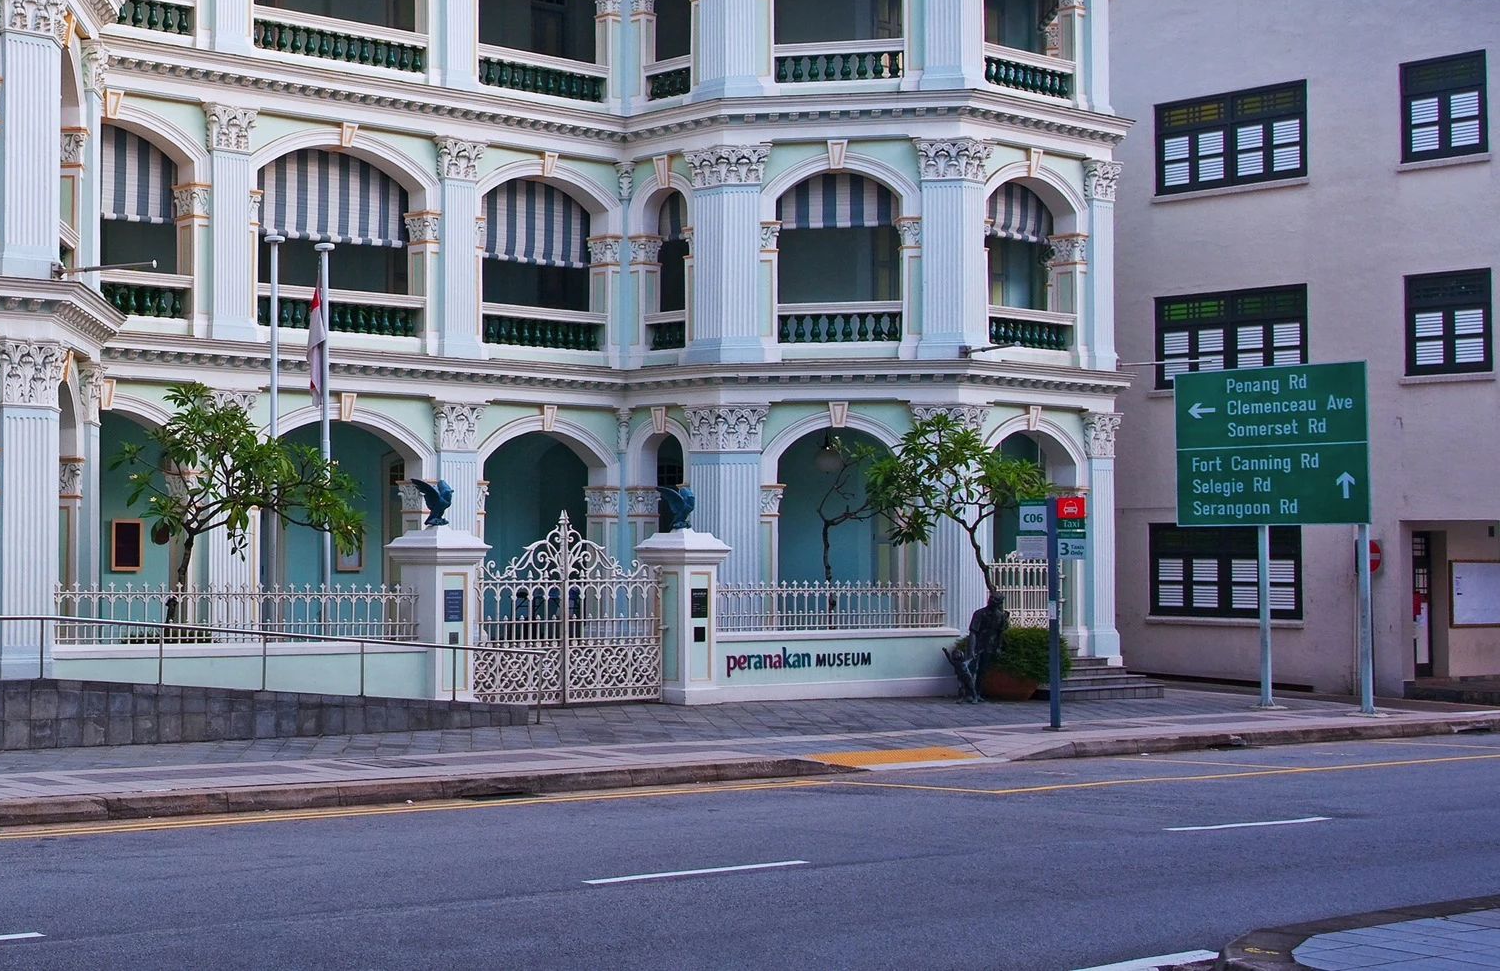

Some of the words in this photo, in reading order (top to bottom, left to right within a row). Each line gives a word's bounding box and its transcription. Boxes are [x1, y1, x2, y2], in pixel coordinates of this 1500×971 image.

[1226, 378, 1280, 395] Penang
[1289, 374, 1307, 390] Rd
[1227, 398, 1316, 416] Clemenceau
[1327, 394, 1353, 410] Ave
[1227, 419, 1298, 438] Somerset
[1308, 417, 1327, 434] Rd
[1192, 456, 1222, 473] Fort
[1231, 455, 1291, 473] Canning
[1301, 453, 1319, 469] Rd
[1192, 479, 1244, 497] Selegie
[1253, 477, 1271, 493] Rd
[1023, 513, 1044, 524] C06
[1193, 501, 1270, 519] Serangoon
[1280, 499, 1298, 515] Rd
[1062, 519, 1080, 528] Taxi
[1060, 542, 1070, 556] 3
[726, 646, 812, 678] peranakan
[815, 652, 872, 668] MUSEUM
